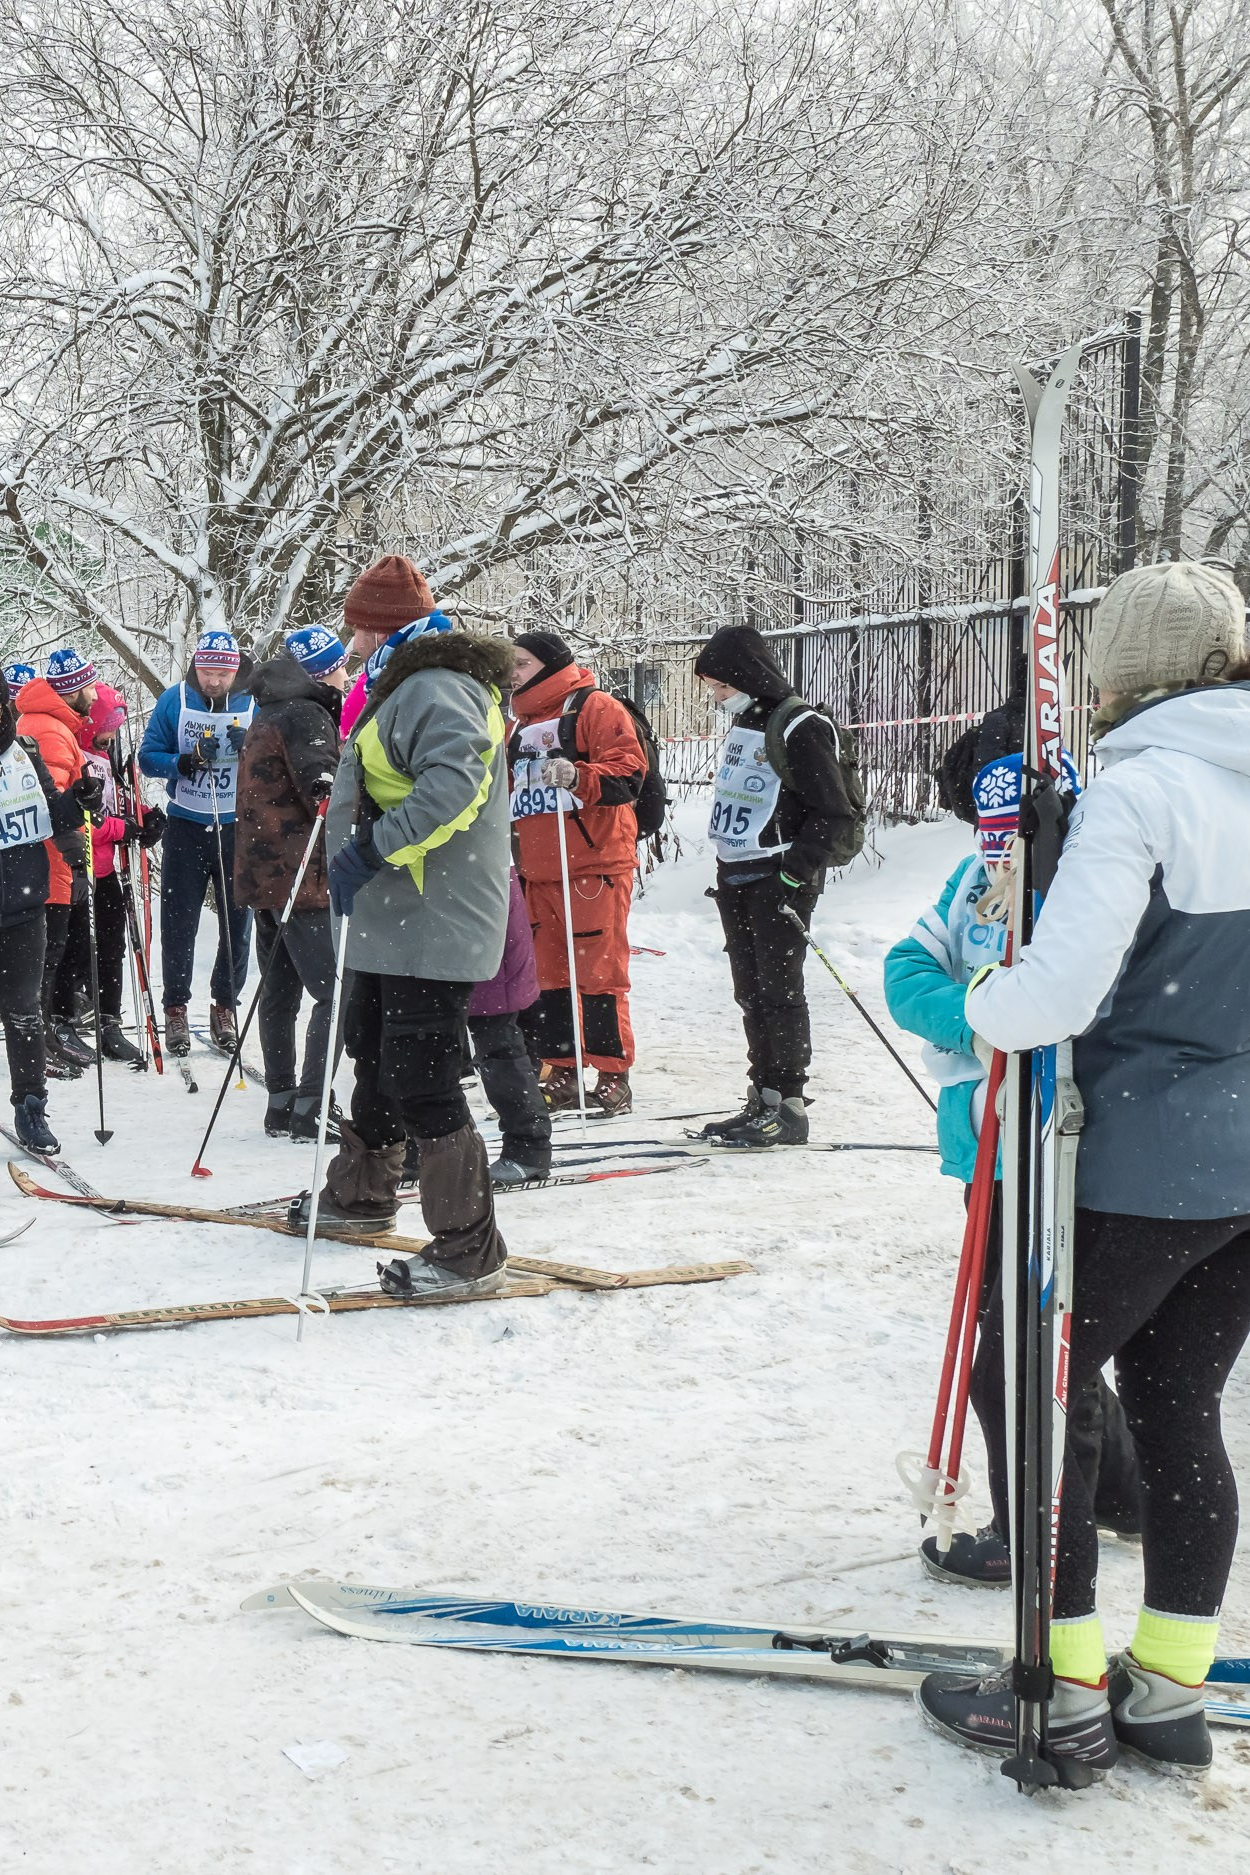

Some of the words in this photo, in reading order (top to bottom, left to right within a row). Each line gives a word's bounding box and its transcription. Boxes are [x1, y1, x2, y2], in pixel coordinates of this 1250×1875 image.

[1037, 582, 1062, 775] ARJALA
[512, 786, 558, 818] 4893
[710, 801, 752, 836] 915
[83, 815, 92, 870] LARSEN
[513, 1603, 620, 1627] KARJALA
